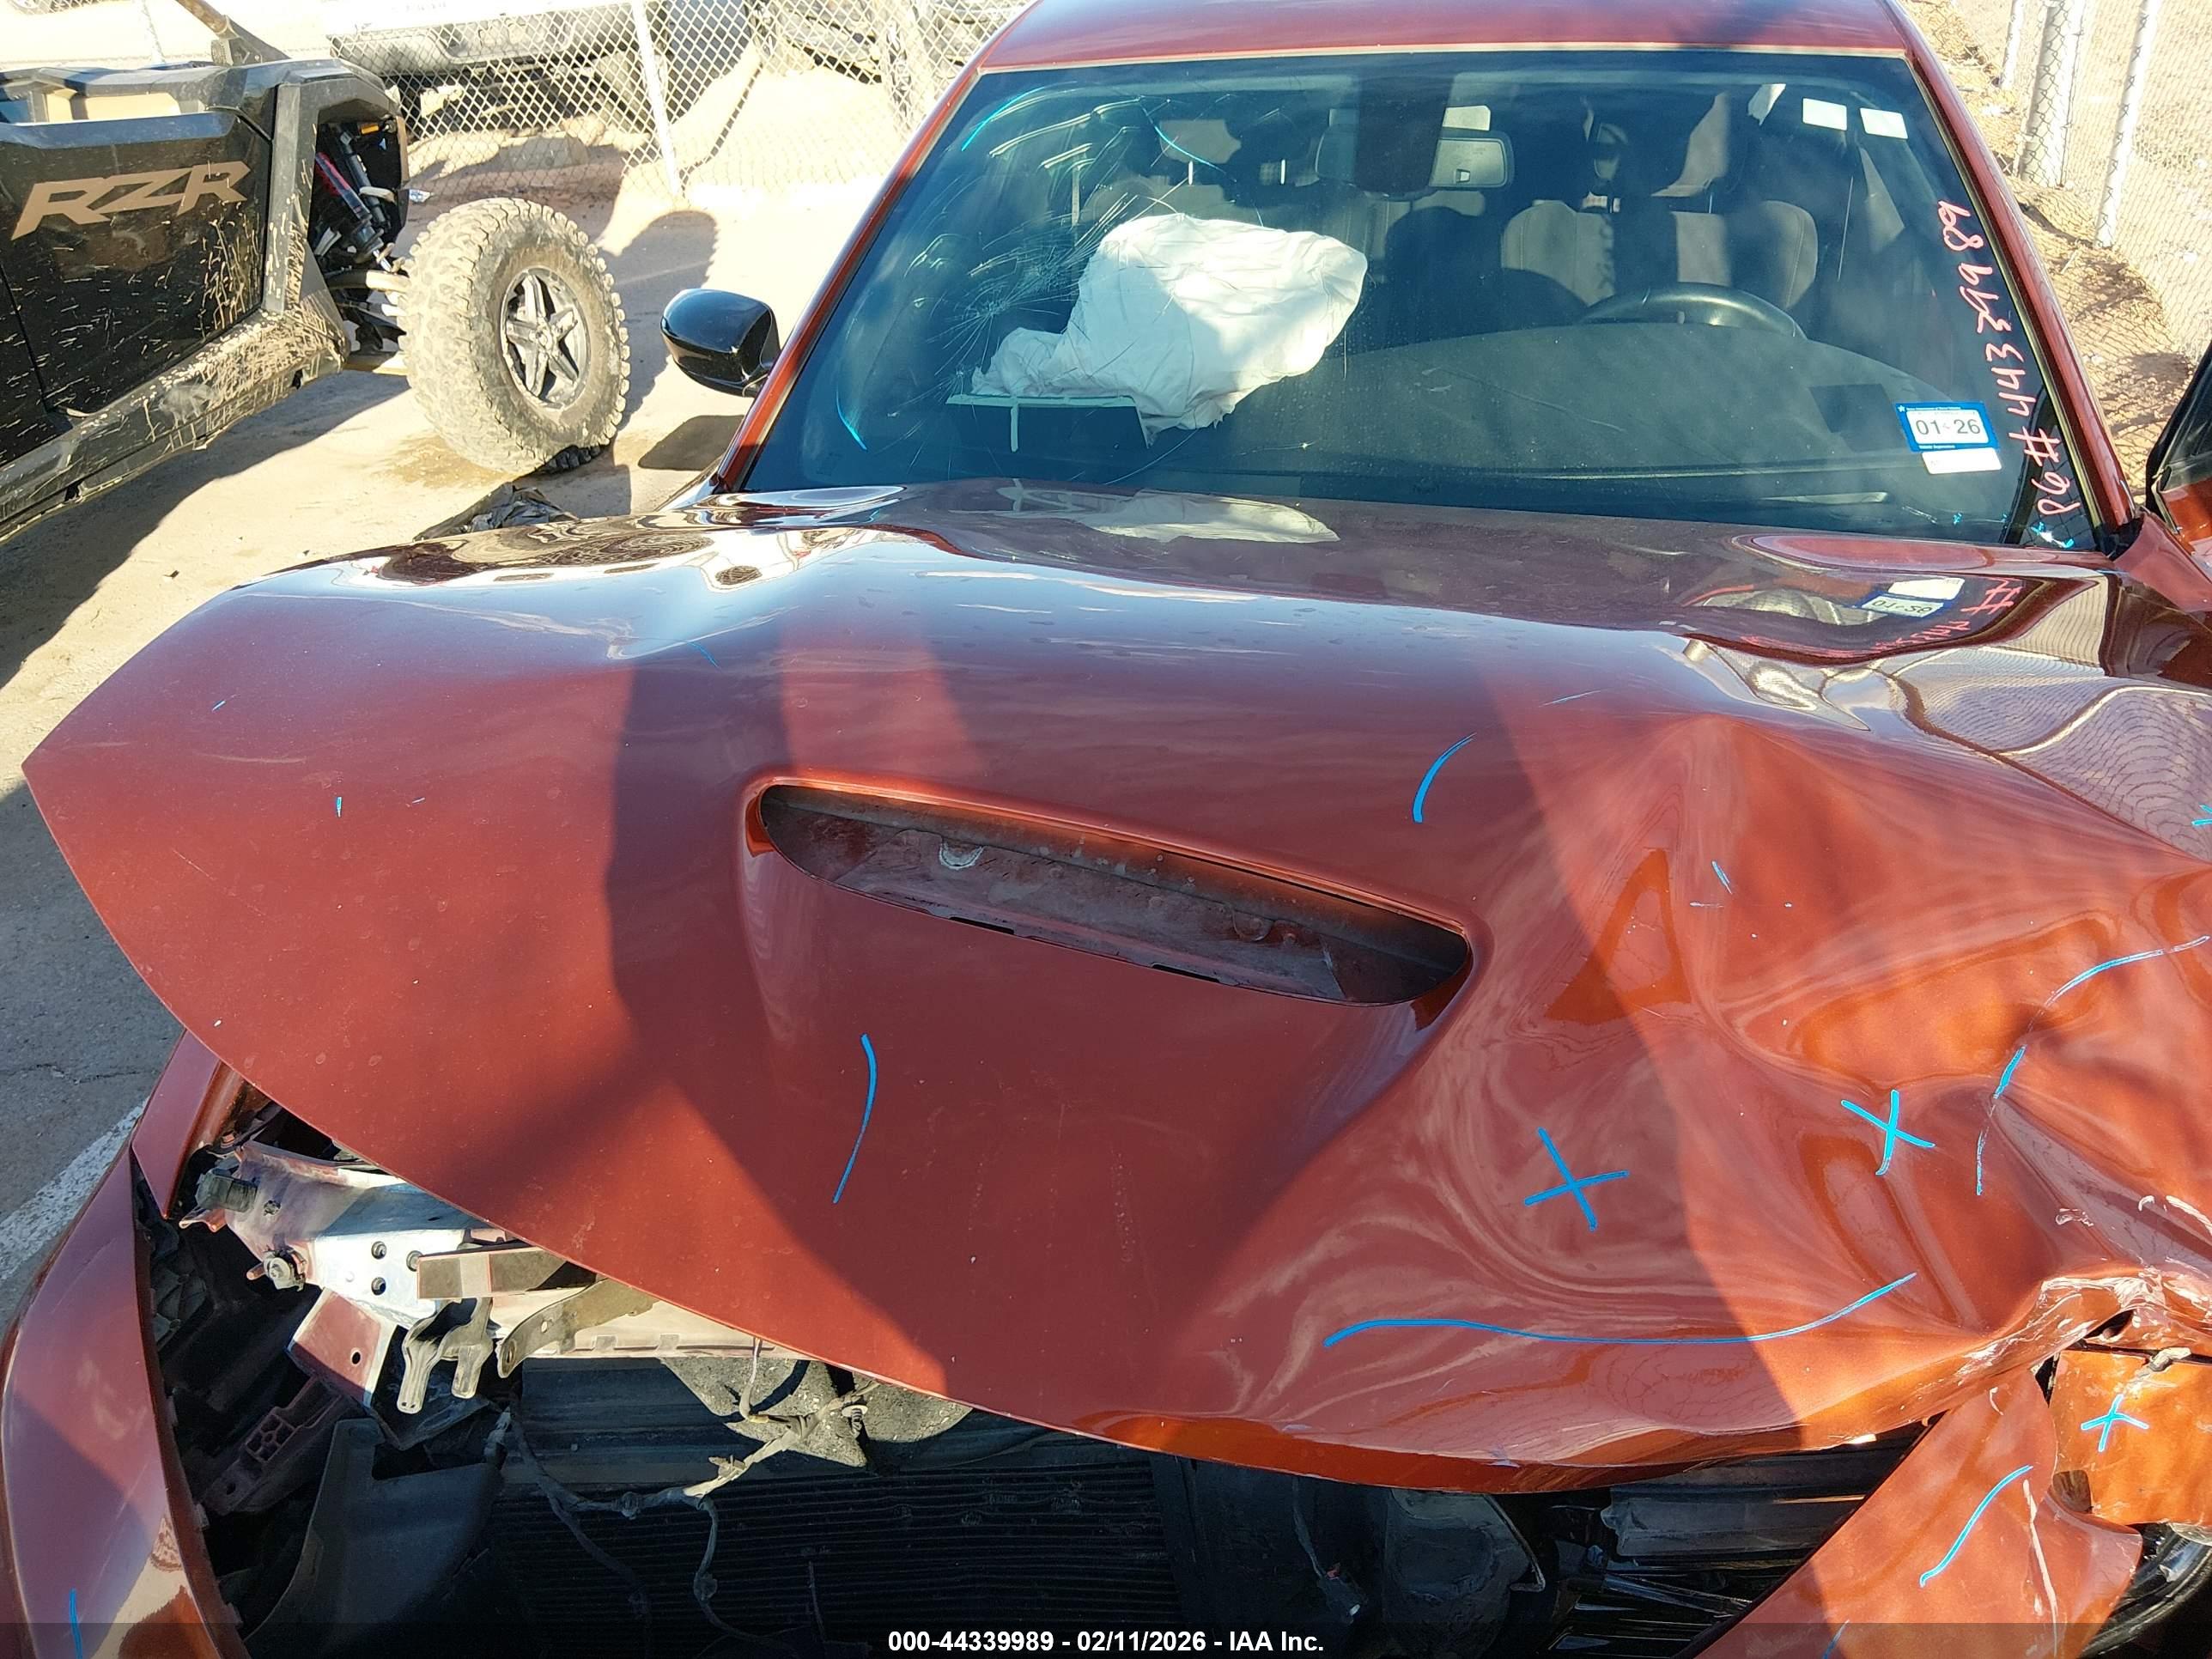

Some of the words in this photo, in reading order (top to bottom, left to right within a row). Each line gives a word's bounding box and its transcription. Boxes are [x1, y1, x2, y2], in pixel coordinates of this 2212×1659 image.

[11, 161, 252, 241] RZR
[1915, 419, 1942, 435] 01
[1953, 418, 1981, 434] 26
